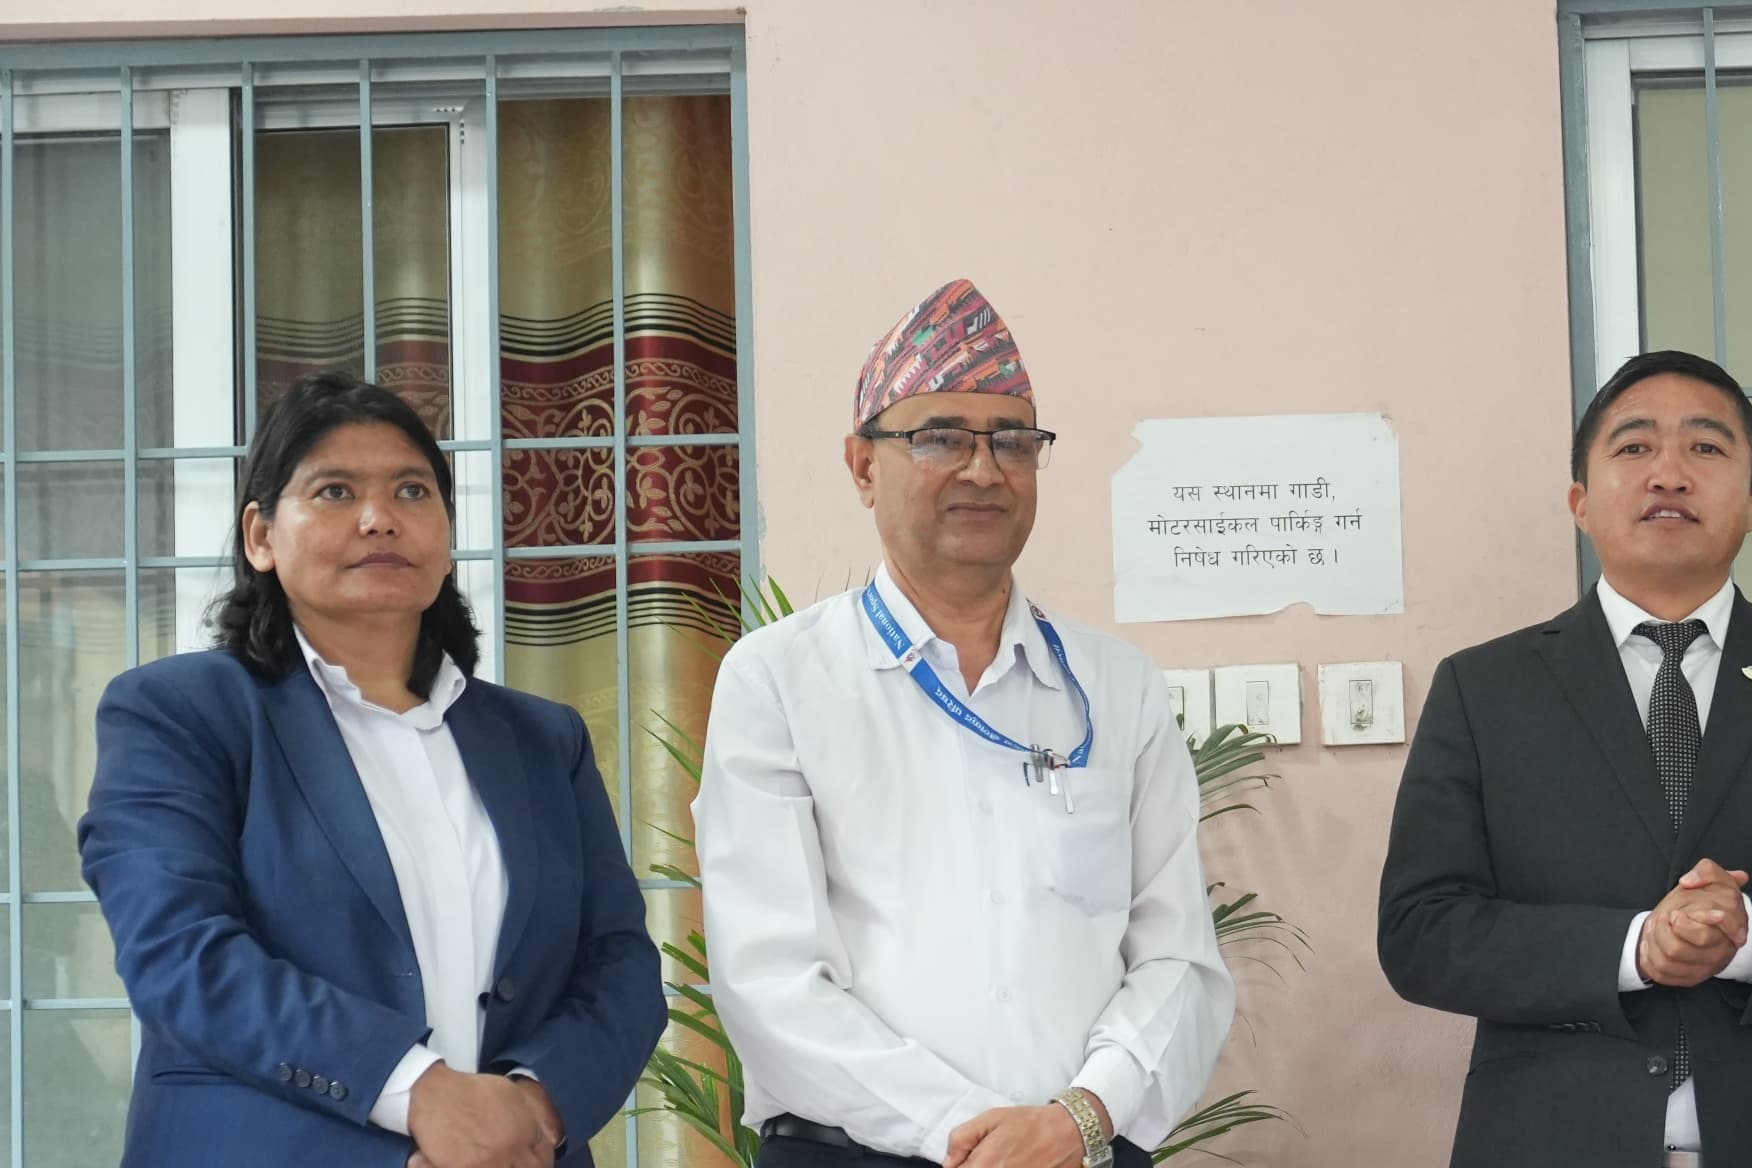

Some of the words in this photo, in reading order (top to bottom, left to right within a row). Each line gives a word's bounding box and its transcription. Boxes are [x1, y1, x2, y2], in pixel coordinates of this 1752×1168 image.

[1171, 485, 1203, 502] यस
[1212, 484, 1279, 501] स्थानमा
[1288, 476, 1335, 502] गाडी,
[1333, 507, 1364, 531] गर्न
[1173, 545, 1221, 568] निषेध
[1231, 543, 1298, 570] गरिएको
[874, 609, 905, 650] National
